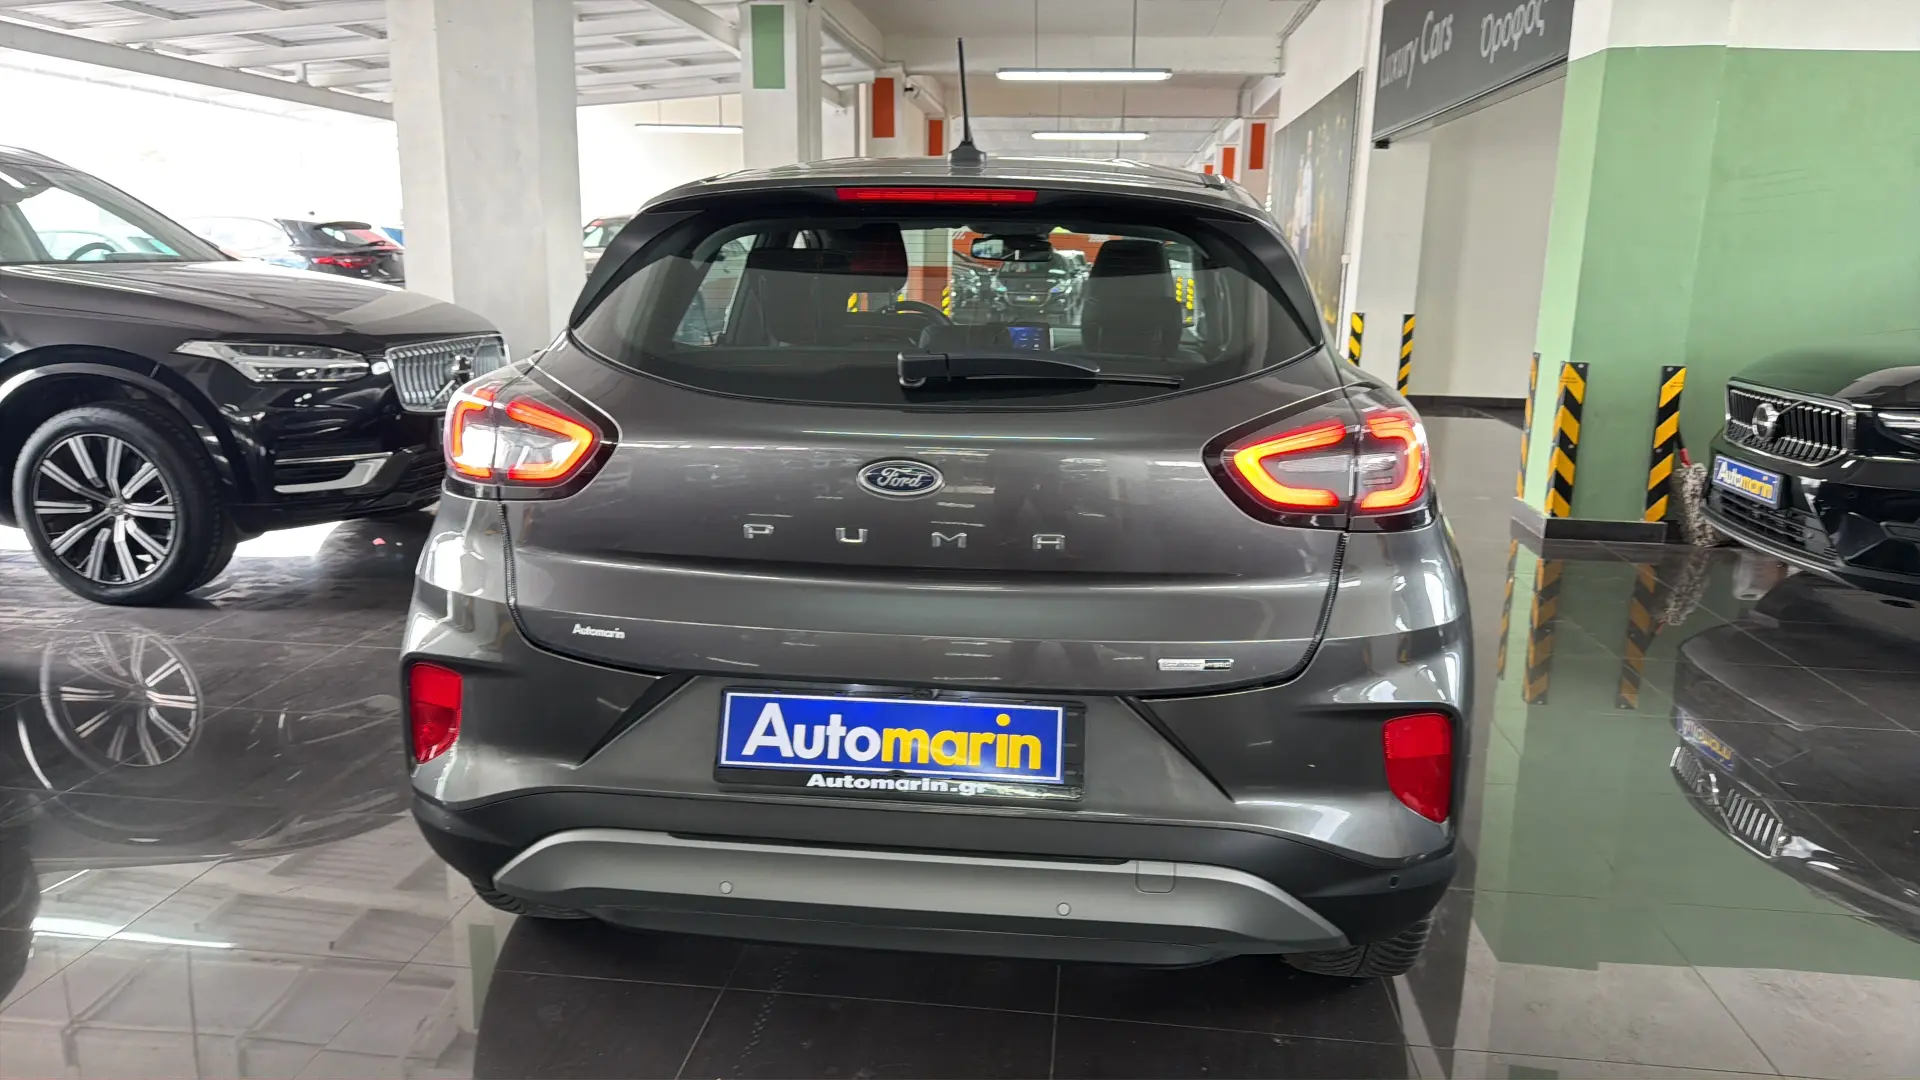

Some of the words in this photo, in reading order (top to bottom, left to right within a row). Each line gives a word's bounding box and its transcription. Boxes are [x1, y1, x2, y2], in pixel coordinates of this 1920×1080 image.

[1380, 37, 1420, 89] Luxury
[1421, 10, 1454, 64] Cars
[877, 467, 925, 487] Ford
[1717, 461, 1774, 499] Automarin
[743, 523, 1066, 550] PUMA
[741, 702, 1041, 770] Automarin
[806, 773, 987, 796] Automarin.gr
